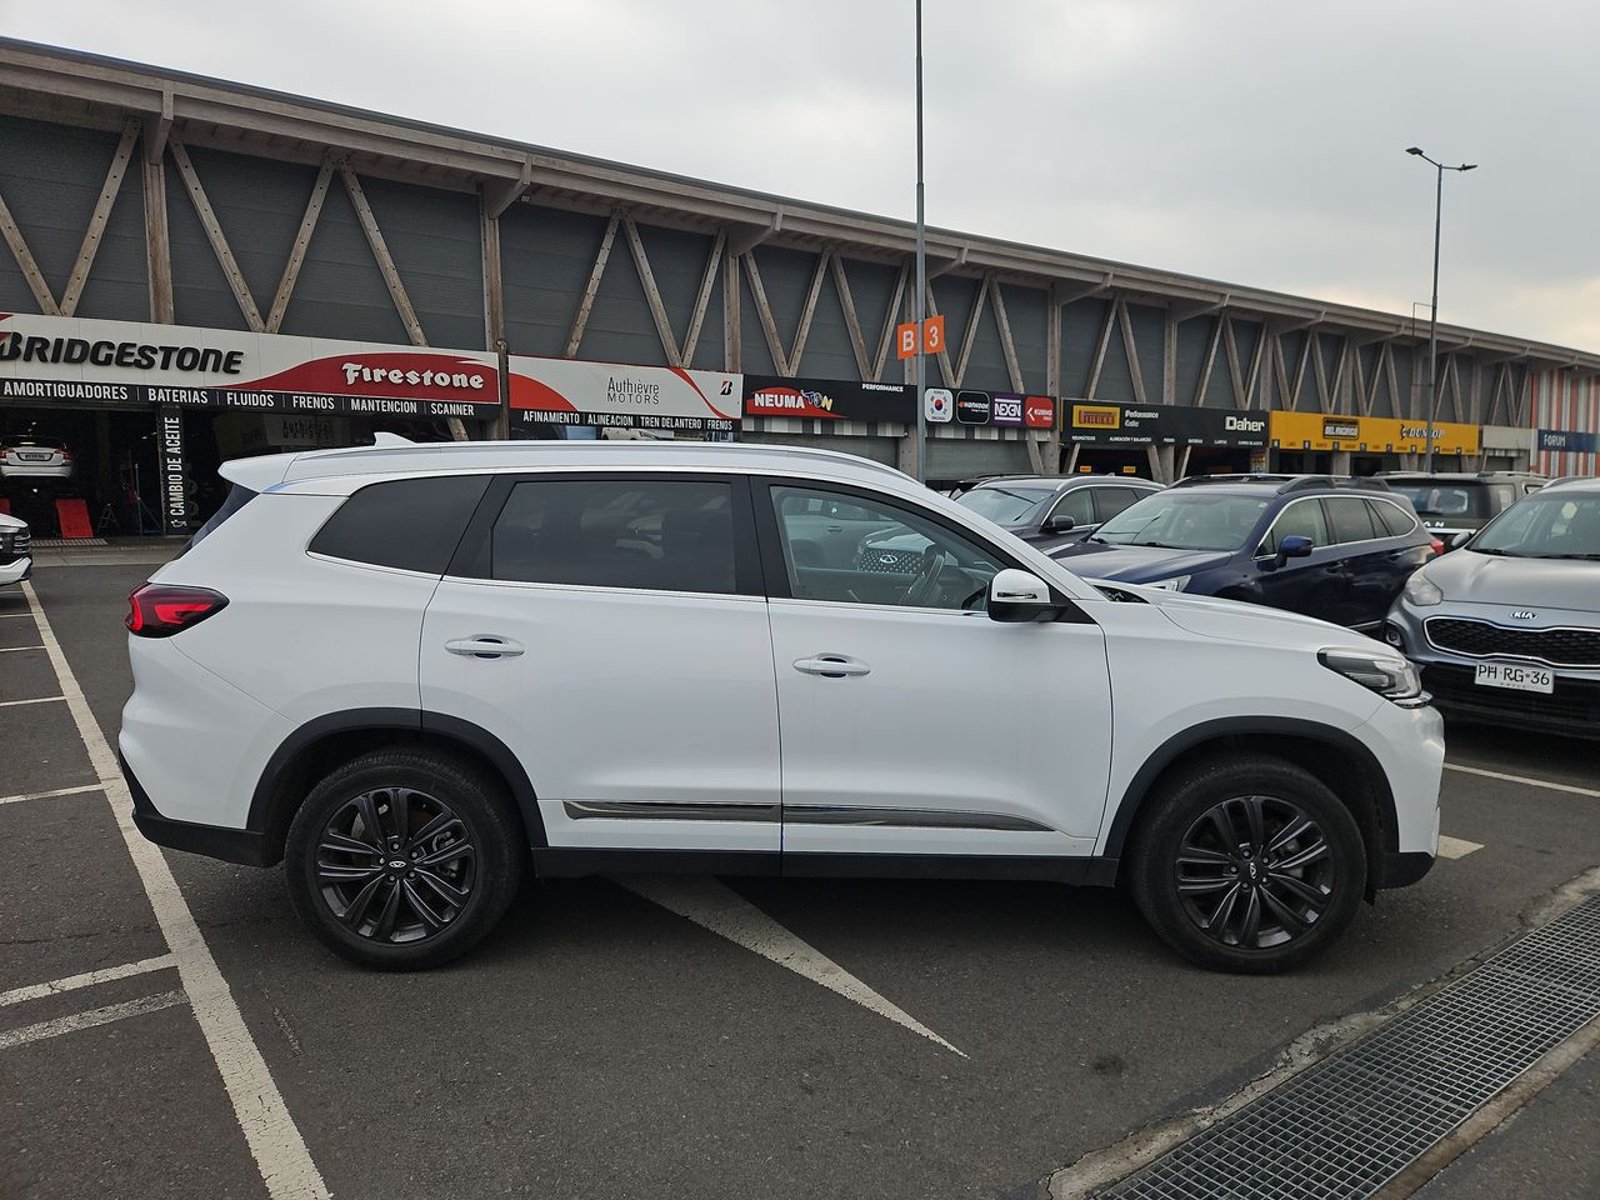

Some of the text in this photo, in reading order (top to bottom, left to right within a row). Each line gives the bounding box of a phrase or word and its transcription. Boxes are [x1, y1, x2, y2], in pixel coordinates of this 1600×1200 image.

[903, 325, 939, 352] B 3
[0, 331, 244, 374] BRIDGESTONE
[342, 361, 484, 390] Firestone
[862, 383, 903, 392] PERFORMANCE
[4, 381, 475, 416] AMORTIGUADORES BATERIAS FLUIDOS FRENOS MANTENCION SCANNER
[607, 393, 660, 405] MOTORS
[523, 411, 733, 431] AFINAMIENTO ALINEACION TREN DELANTERO FRENOS
[1225, 416, 1265, 431] Daher
[1544, 434, 1565, 446] FORUM
[164, 416, 185, 516] CAMBIO DE ACEITE
[1513, 611, 1534, 619] KIA
